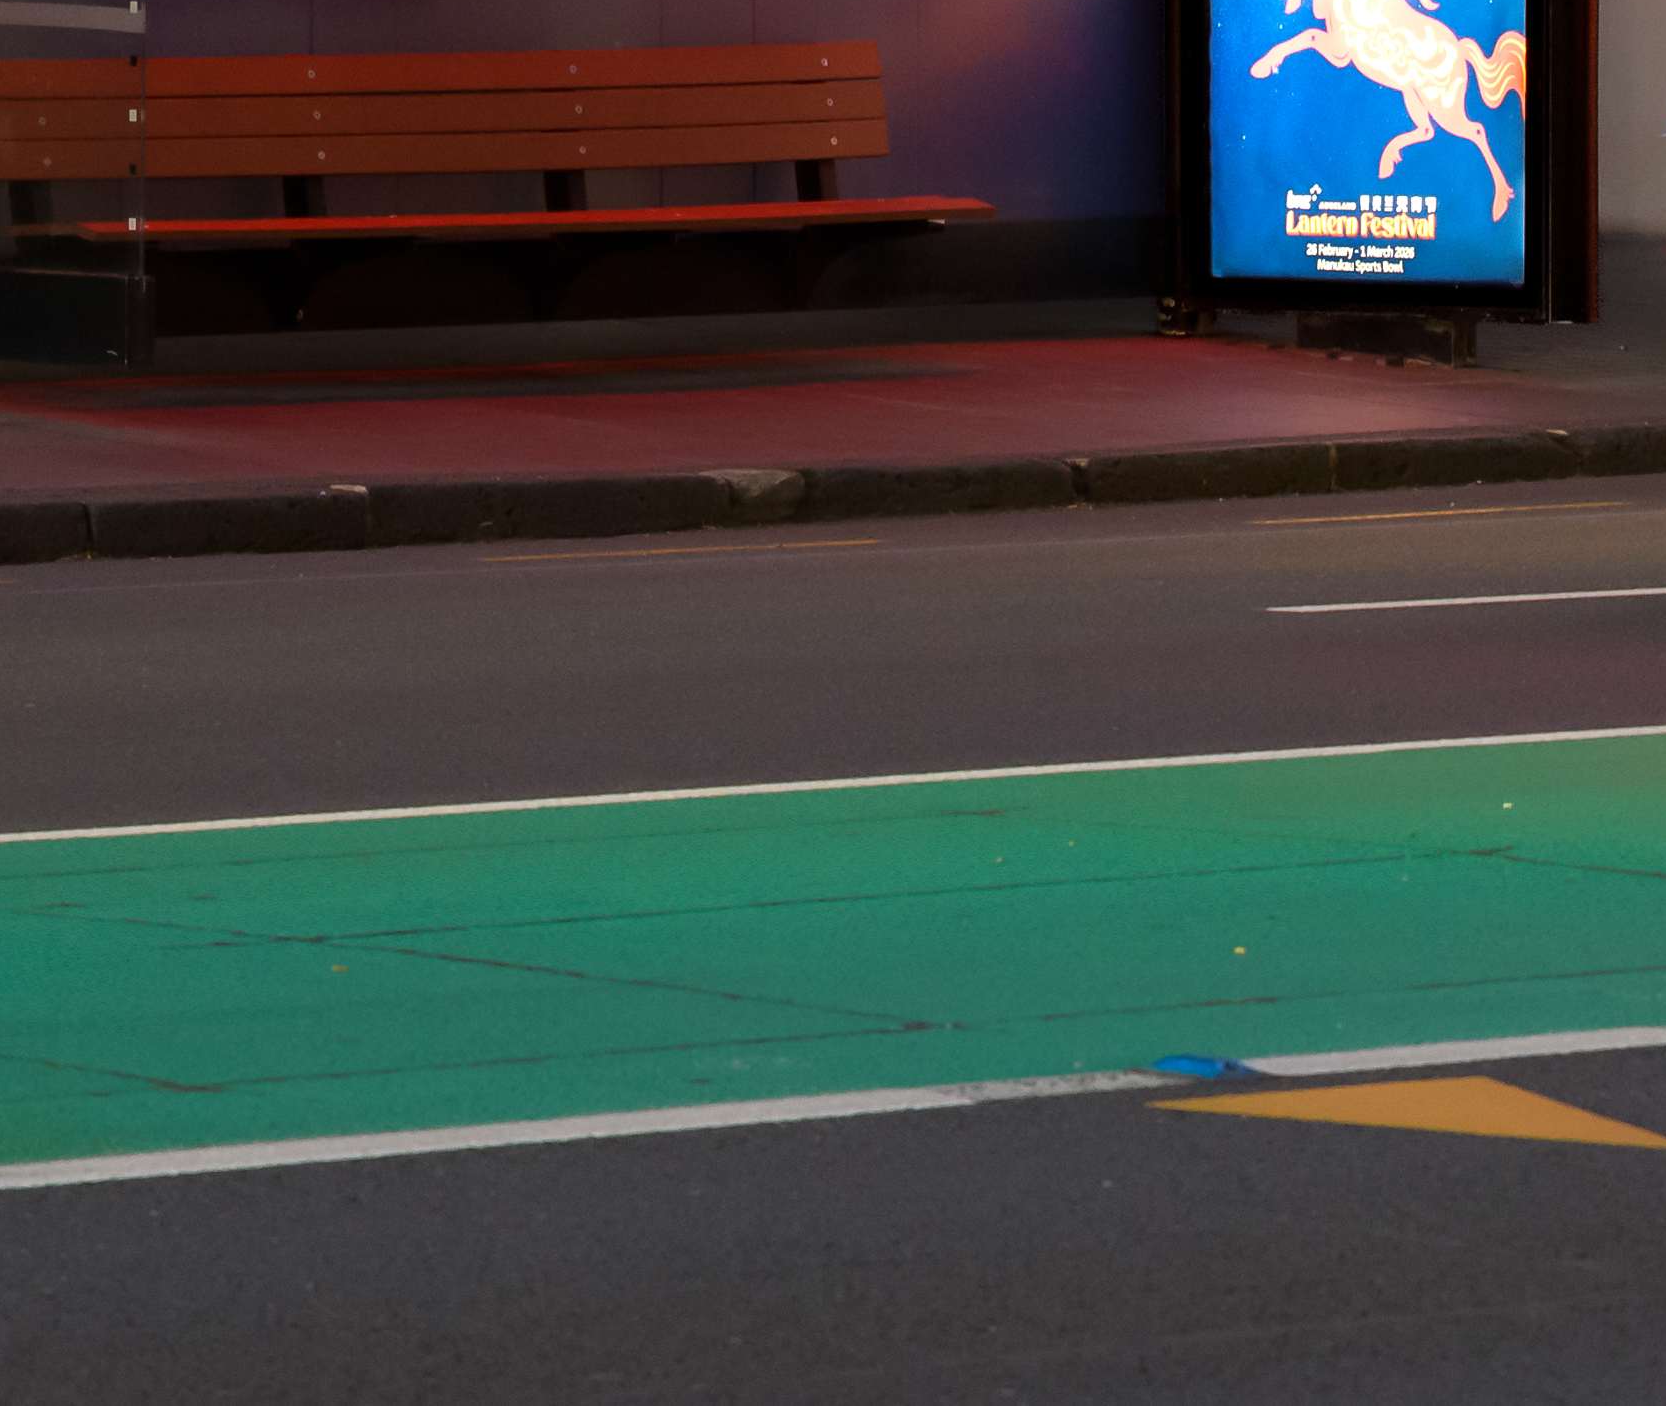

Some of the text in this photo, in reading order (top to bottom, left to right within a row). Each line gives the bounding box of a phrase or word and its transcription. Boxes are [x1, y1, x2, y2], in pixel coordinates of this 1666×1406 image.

[1286, 210, 1436, 240] Lantern Festival
[1318, 243, 1353, 259] February
[1360, 245, 1366, 257] 1
[1367, 245, 1393, 258] March
[1316, 258, 1404, 274] Manukau Sports Bowl
